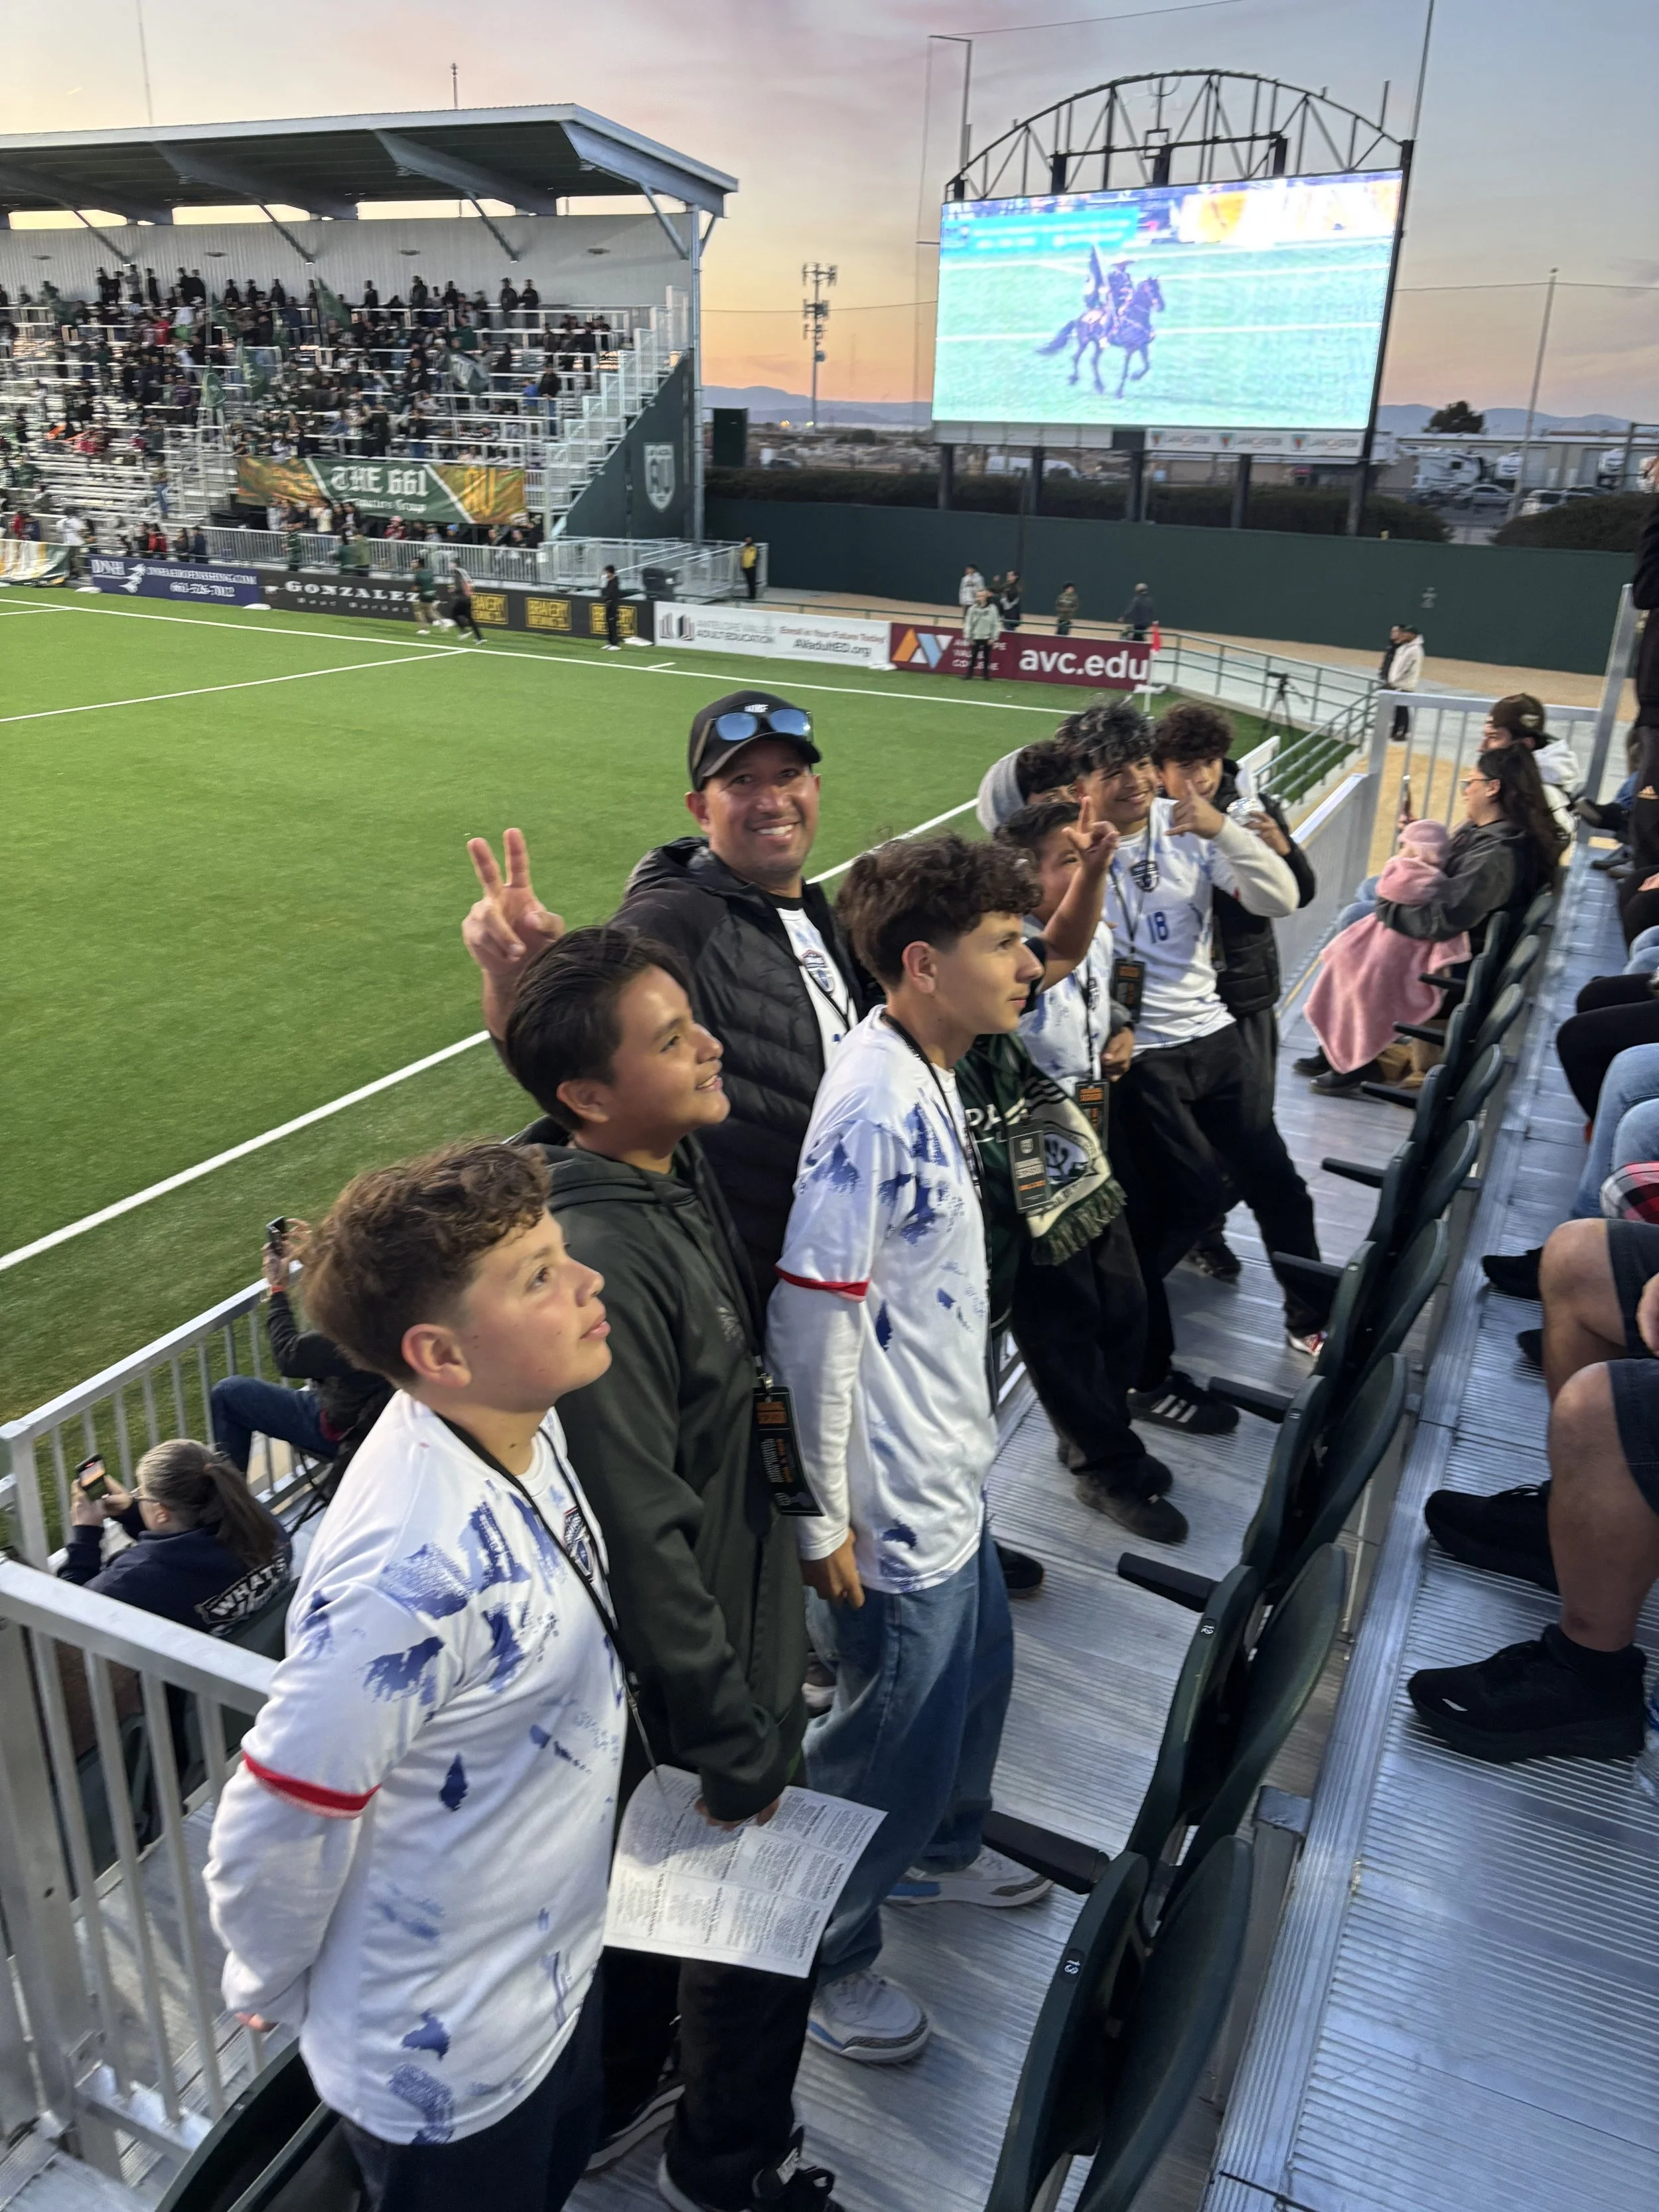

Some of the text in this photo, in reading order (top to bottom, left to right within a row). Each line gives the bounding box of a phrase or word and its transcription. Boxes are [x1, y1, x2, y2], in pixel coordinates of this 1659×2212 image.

[331, 466, 384, 493] THE
[386, 469, 429, 496] 661
[285, 581, 421, 603] GONZALEZ
[1019, 649, 1149, 681] avc.edu
[1147, 911, 1169, 944] 18
